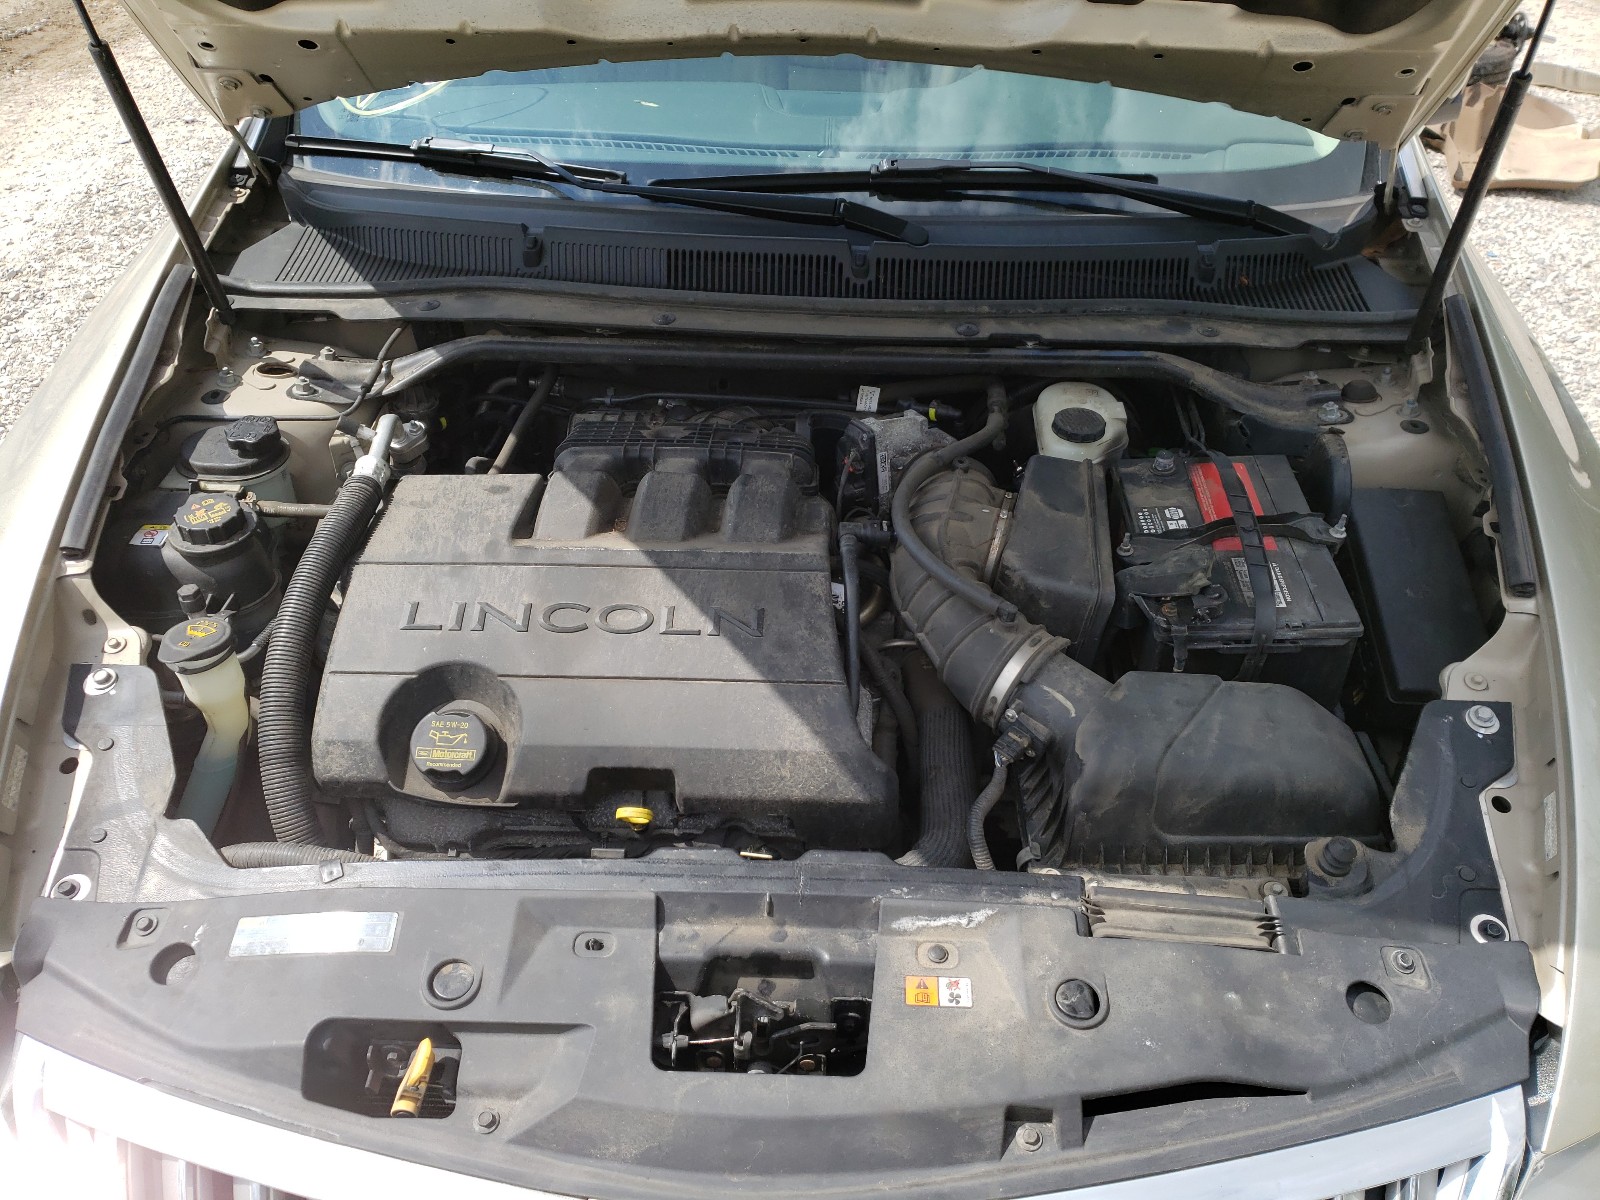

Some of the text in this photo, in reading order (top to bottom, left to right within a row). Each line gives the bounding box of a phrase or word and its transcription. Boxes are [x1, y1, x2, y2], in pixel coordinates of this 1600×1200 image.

[399, 600, 765, 637] LINCOLN
[431, 720, 469, 729] SAE 5W-20
[432, 749, 473, 759] Motorcraft
